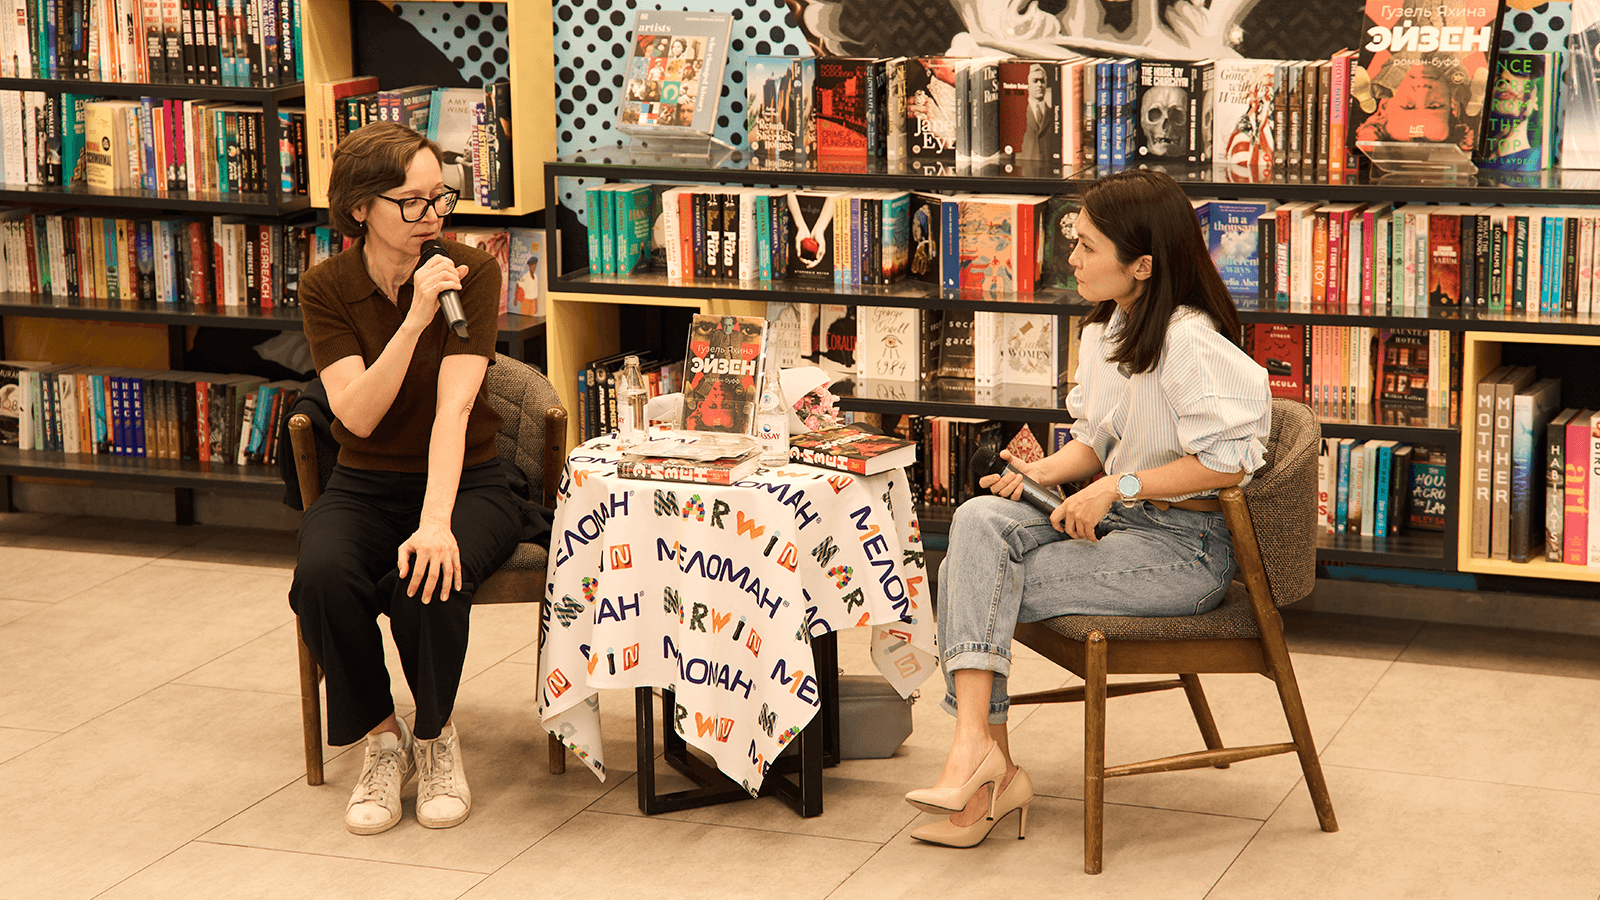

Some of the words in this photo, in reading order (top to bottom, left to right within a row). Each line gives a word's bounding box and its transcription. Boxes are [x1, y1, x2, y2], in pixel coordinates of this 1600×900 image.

[1381, 5, 1432, 20] Гузель
[1437, 5, 1486, 17] Яхина
[638, 22, 671, 33] artists
[1364, 19, 1491, 53] ЭЙЗЕН
[89, 30, 98, 57] WILL
[281, 22, 291, 61] DEAVER
[702, 53, 713, 85] changed
[1141, 66, 1153, 76] THE
[1153, 67, 1174, 77] HOUSE
[1174, 68, 1184, 78] BY
[1393, 57, 1460, 68] роман-буфф
[1497, 59, 1533, 73] NCE
[983, 66, 998, 80] The
[1141, 76, 1153, 86] THE
[1220, 68, 1247, 81] Gone
[1228, 80, 1251, 92] with
[1495, 79, 1531, 93] ORE
[696, 86, 708, 112] history
[1218, 91, 1250, 104] Wind
[1491, 99, 1530, 113] ROM
[913, 115, 954, 137] Jane
[1489, 118, 1521, 132] THE
[486, 123, 496, 148] CAT
[922, 132, 956, 154] Eyr
[1487, 138, 1522, 152] TOP
[1213, 221, 1258, 233] thousan
[1228, 213, 1239, 224] in
[1316, 217, 1326, 243] Stephen
[707, 231, 720, 266] Puzo
[724, 231, 737, 266] Puzo
[261, 231, 270, 298] OVERREACH
[1225, 266, 1251, 276] ways
[1277, 243, 1288, 293] AMERICANAH
[1314, 259, 1325, 288] TROY
[1378, 267, 1385, 278] ME
[873, 305, 904, 324] George
[874, 319, 910, 335] Orwell
[949, 320, 975, 329] secr
[1390, 329, 1429, 337] HAUNTED
[698, 344, 725, 354] Гузель
[727, 346, 753, 355] Яхина
[945, 336, 975, 347] gard
[1395, 337, 1422, 345] HOTEL
[1008, 347, 1050, 360] WOMEN
[690, 354, 756, 376] ЭЙЗЕН
[876, 358, 907, 378] 1984
[608, 388, 616, 398] DC
[1270, 380, 1298, 389] ACULA
[111, 382, 119, 418] HERC
[122, 382, 130, 418] HERC
[133, 382, 141, 418] HERC
[609, 399, 617, 427] COMICS
[1477, 394, 1491, 500] MOTHER
[1495, 396, 1510, 503] MOTHER
[1355, 456, 1363, 469] THE
[1355, 471, 1363, 490] FOUR
[1565, 463, 1589, 517] art
[1412, 486, 1446, 500] ACRO
[1550, 445, 1561, 542] HABITATS
[733, 480, 818, 532] ОМАН
[1354, 491, 1362, 515] WINDS
[1410, 514, 1433, 524] RILEY
[654, 489, 799, 573] MARWIN
[849, 505, 913, 623] МЕЛОМ
[657, 537, 783, 619] МЕЛОМАН
[663, 585, 763, 661] MRWIN
[675, 703, 735, 744] RWIN
